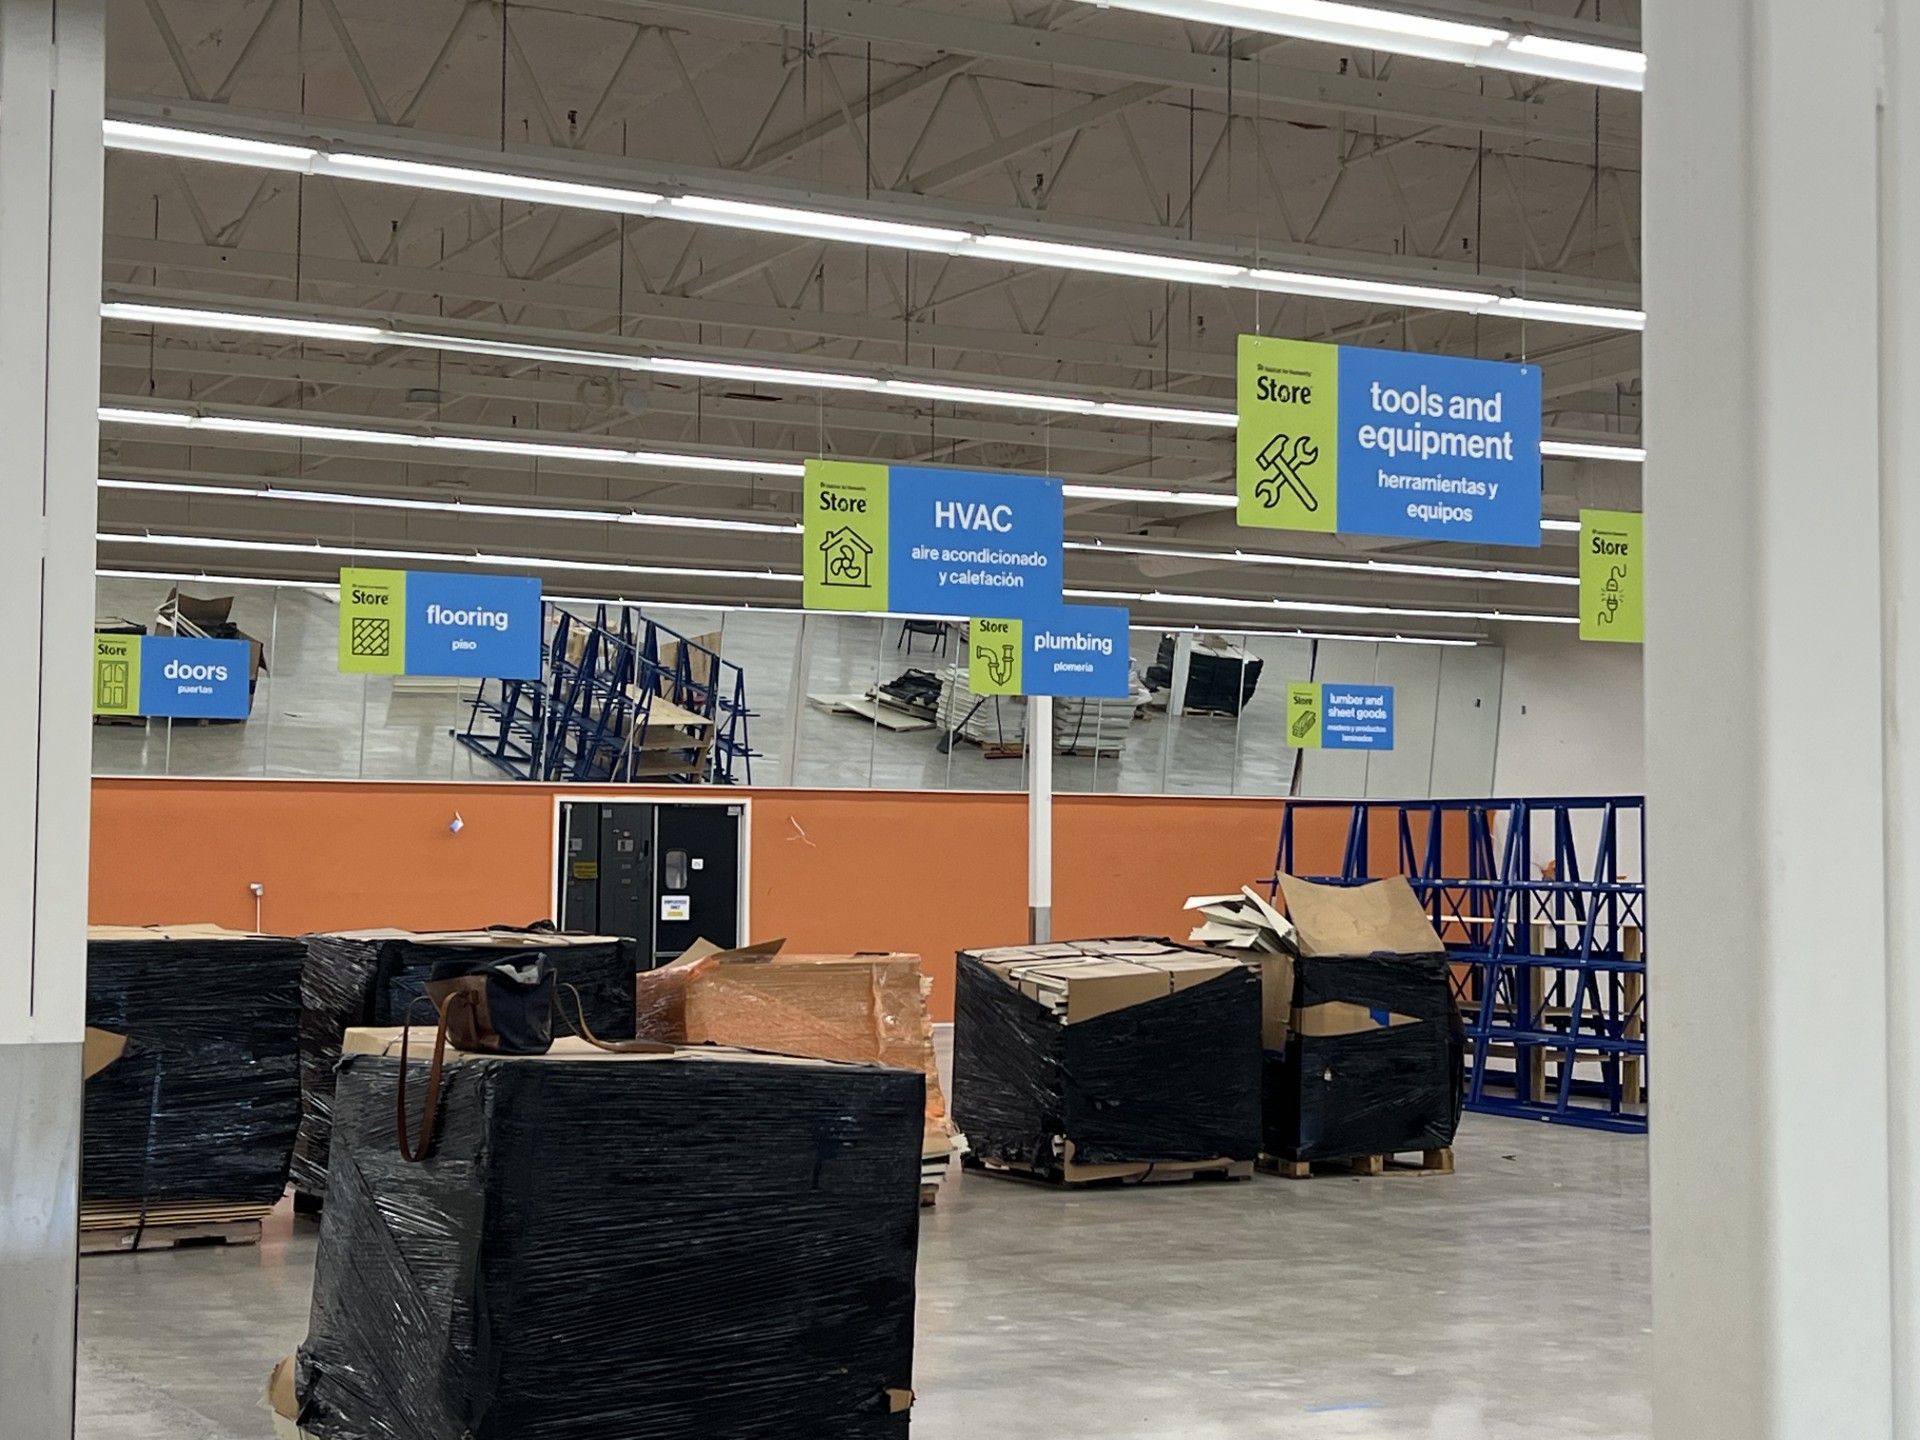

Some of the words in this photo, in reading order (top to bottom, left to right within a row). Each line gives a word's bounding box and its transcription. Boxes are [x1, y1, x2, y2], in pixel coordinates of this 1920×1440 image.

[1256, 375, 1311, 405] Store
[1370, 381, 1443, 417] tools
[1449, 392, 1502, 423] and
[1358, 422, 1514, 461] equipment
[1378, 469, 1485, 497] herramientas
[1488, 482, 1499, 500] y
[819, 490, 867, 513] Store
[1407, 502, 1473, 524] equipos
[935, 500, 1013, 533] HVAC
[911, 544, 940, 561] aire
[941, 547, 1048, 567] acondicionado
[1591, 536, 1629, 556] Store
[938, 571, 947, 586] y
[949, 569, 1024, 588] calefación
[352, 589, 389, 605] Store
[426, 604, 509, 632] flooring
[979, 619, 1009, 634] Store
[97, 643, 127, 657] Store
[452, 638, 477, 652] piso
[1034, 630, 1113, 656] plumbing
[163, 659, 229, 682] doors
[1329, 692, 1364, 706] lumber
[1364, 694, 1384, 706] and
[1327, 705, 1356, 718] sheet
[1356, 707, 1388, 721] goods
